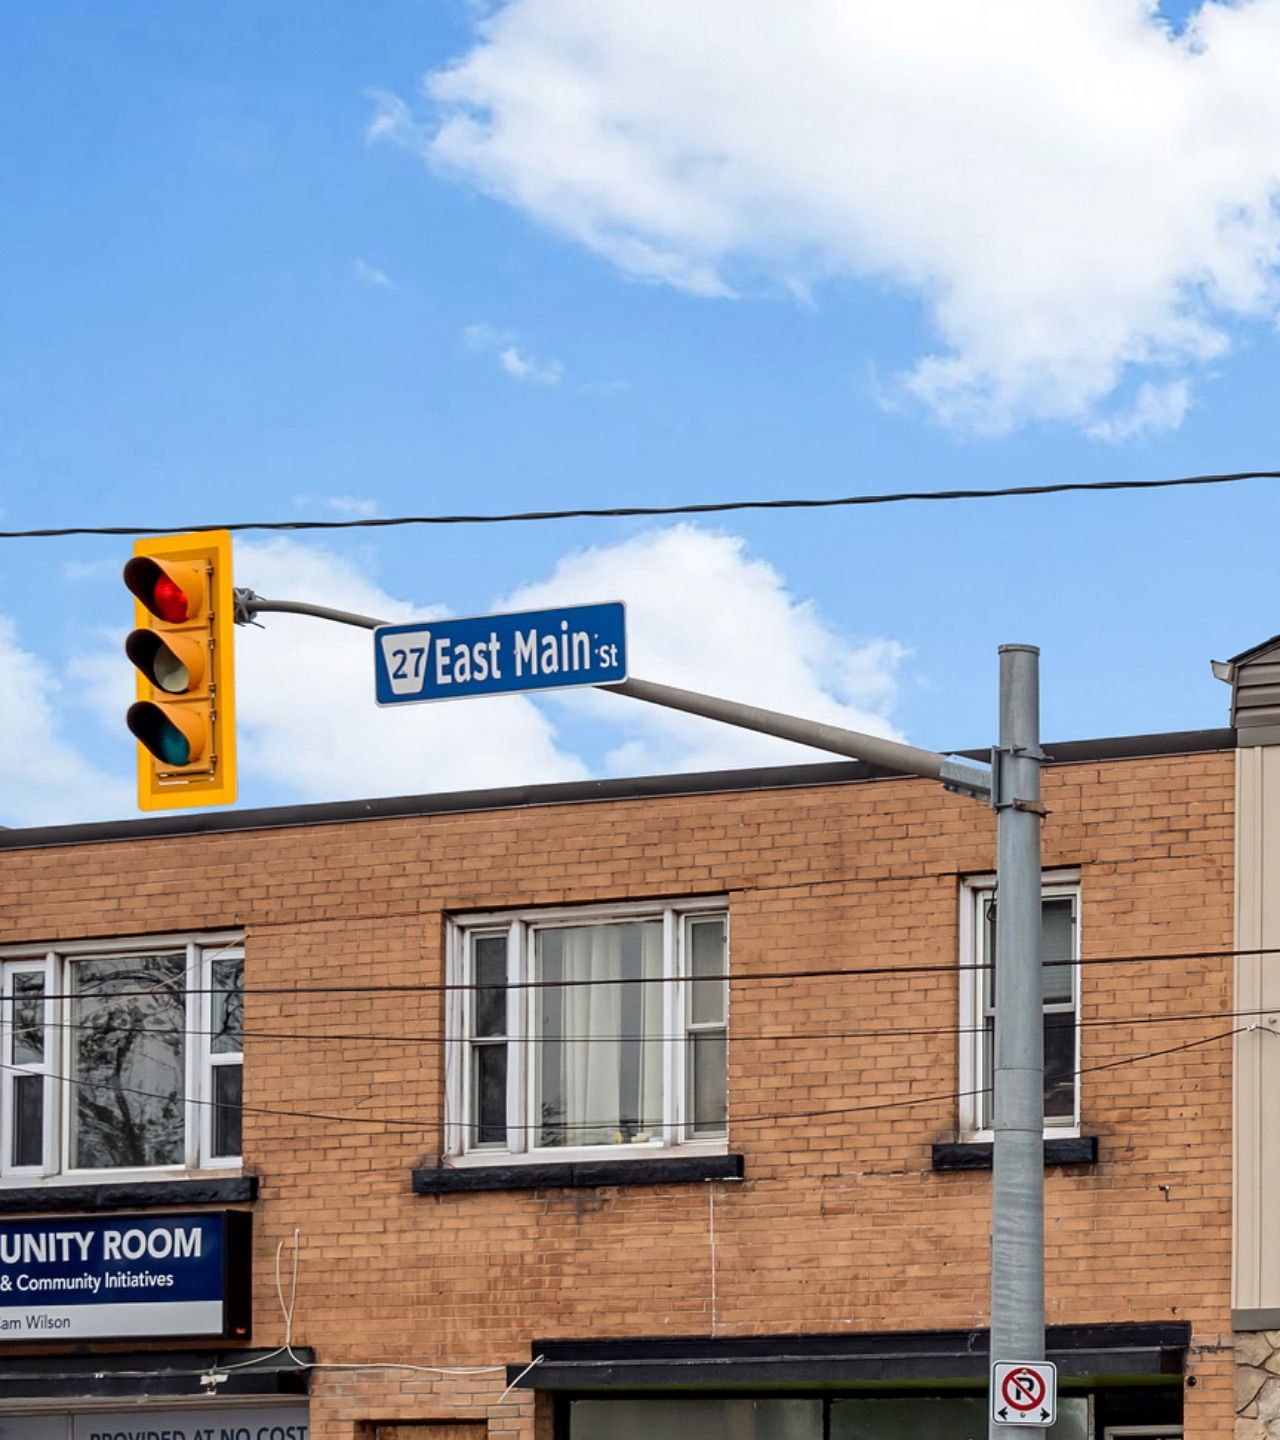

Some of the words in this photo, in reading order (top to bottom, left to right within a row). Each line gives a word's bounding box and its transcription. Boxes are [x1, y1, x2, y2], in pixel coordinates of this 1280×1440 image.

[392, 647, 425, 680] 27
[435, 632, 502, 685] East
[514, 620, 592, 677] Main
[0, 1231, 95, 1265] UNITY
[103, 1227, 202, 1261] ROOM
[0, 1274, 13, 1291] &
[17, 1272, 102, 1294] Community
[105, 1270, 174, 1288] Initiatives
[0, 1318, 21, 1330] am
[26, 1314, 71, 1330] Wilson
